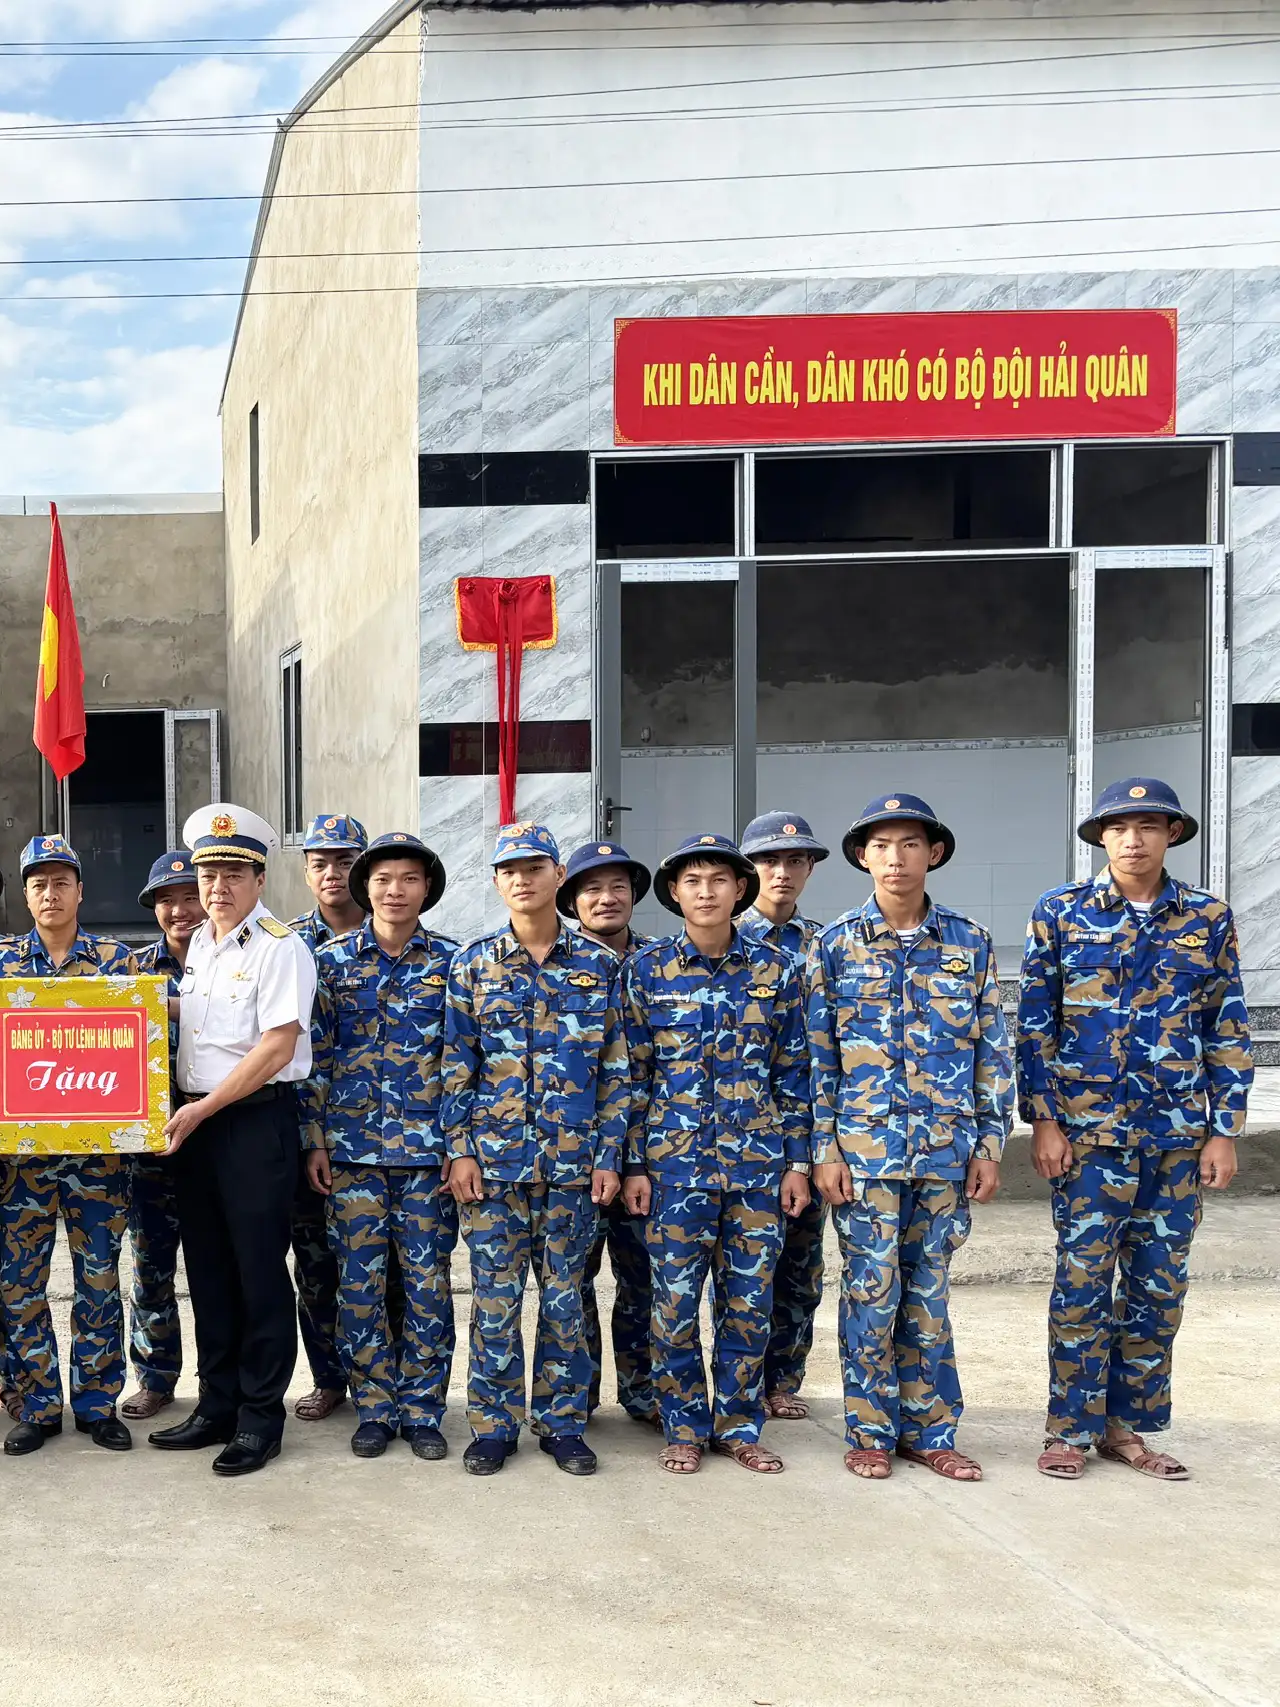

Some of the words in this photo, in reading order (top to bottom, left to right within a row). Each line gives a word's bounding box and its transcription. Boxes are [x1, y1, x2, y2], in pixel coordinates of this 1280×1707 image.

[644, 363, 682, 406] KHI
[689, 353, 737, 405] DÂN
[744, 345, 799, 409] CẦN,
[807, 351, 855, 403] DÂN
[862, 349, 909, 402] KHÓ
[917, 348, 948, 401] CÓ
[955, 348, 986, 409] BỘ
[992, 347, 1032, 409] ĐỘI
[1039, 341, 1078, 398] HẢI
[1085, 345, 1148, 403] QUÂN
[11, 1022, 32, 1049] ĐẢNG
[35, 1022, 45, 1049] ỦY
[52, 1024, 63, 1053] BỘ
[64, 1026, 75, 1049] TƯ
[76, 1024, 96, 1053] LỆNH
[98, 1021, 110, 1049] HẢI
[113, 1024, 134, 1050] QUÂN
[26, 1061, 119, 1096] Tặng
